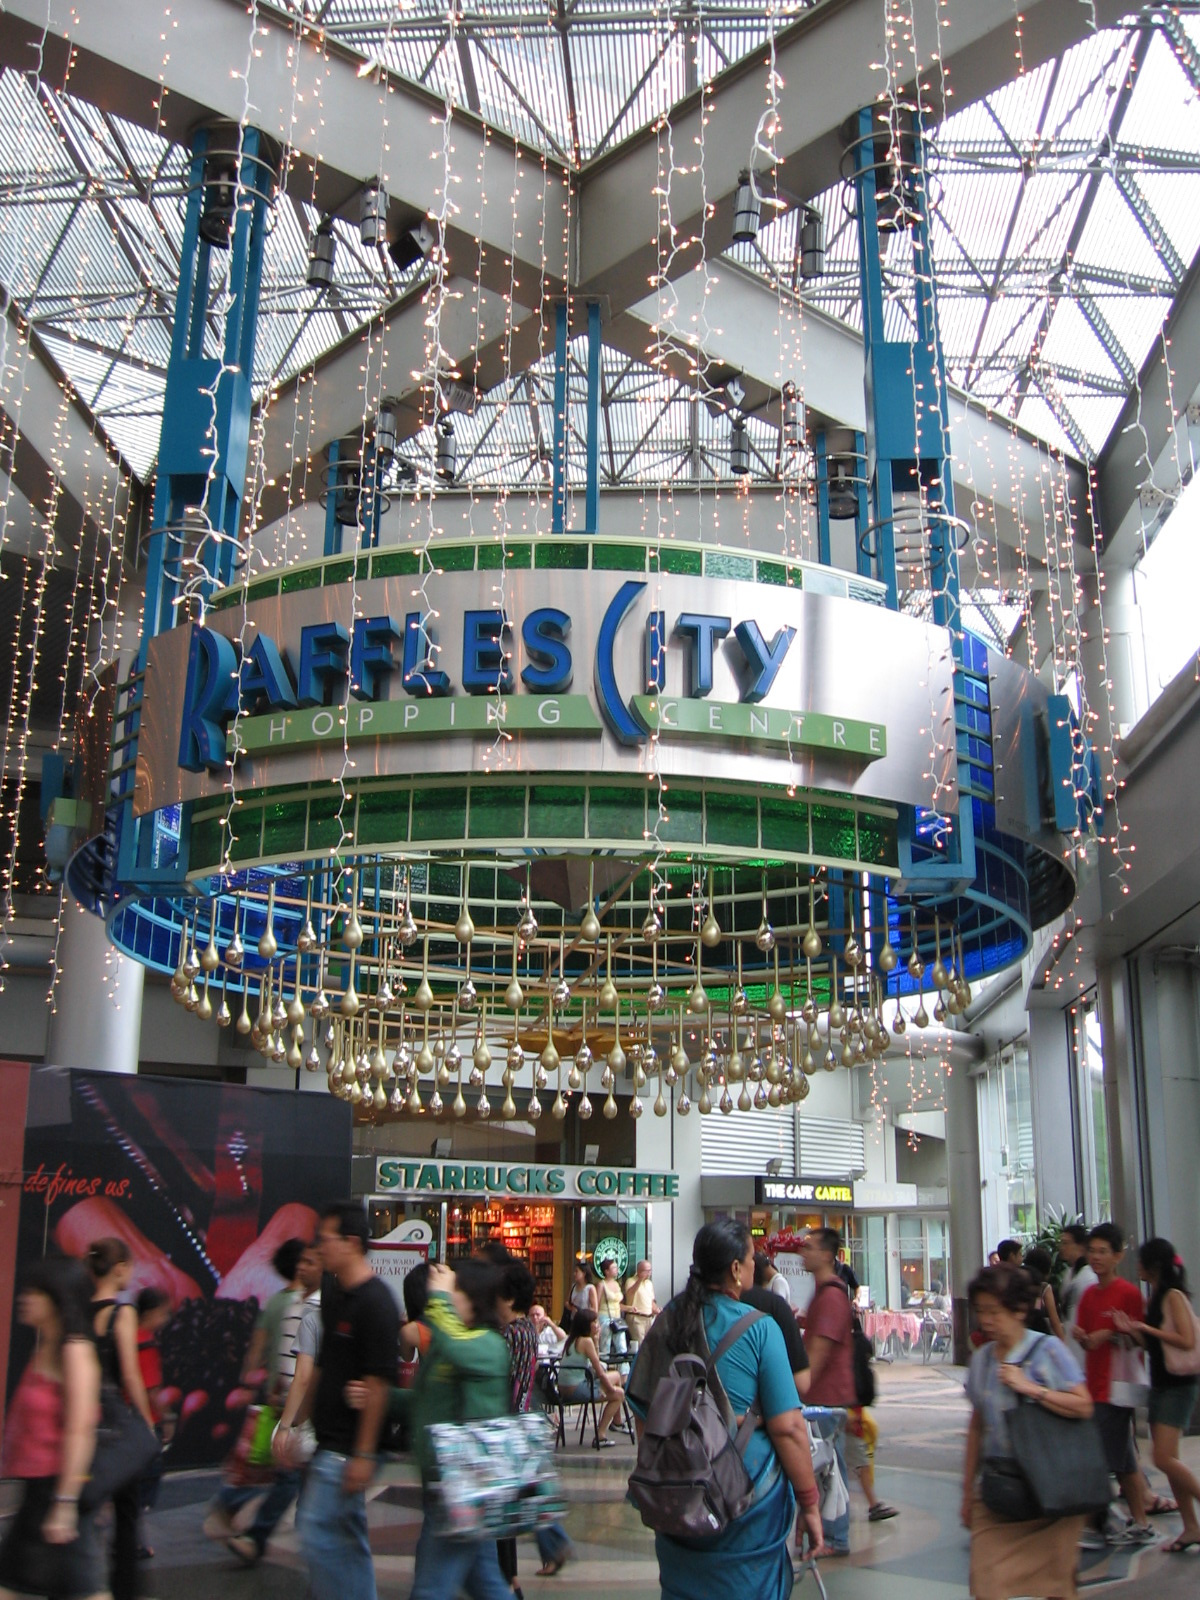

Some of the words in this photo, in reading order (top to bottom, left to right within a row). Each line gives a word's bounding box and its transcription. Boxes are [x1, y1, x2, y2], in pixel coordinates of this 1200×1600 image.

[178, 608, 574, 772] RAFFLES
[594, 580, 798, 747] CITY
[230, 699, 562, 749] SHOPPING
[662, 701, 882, 753] CENTRE
[24, 1162, 102, 1205] defines
[105, 1177, 132, 1199] us.
[379, 1161, 566, 1194] STARBUCKS
[577, 1170, 680, 1197] COFFEE
[764, 1183, 786, 1198] THE
[815, 1186, 852, 1201] CARTEL
[392, 1258, 415, 1266] WARM
